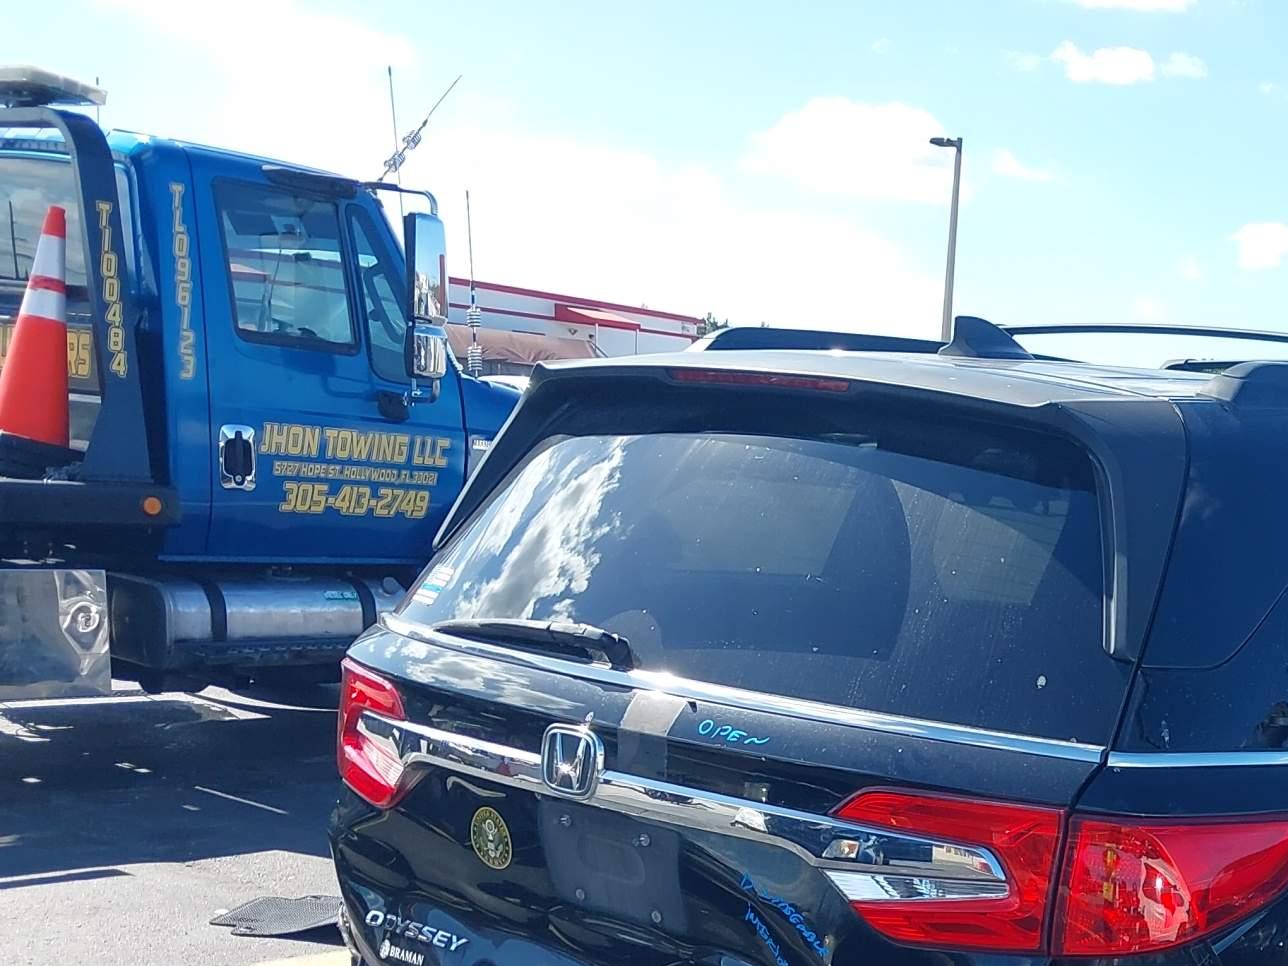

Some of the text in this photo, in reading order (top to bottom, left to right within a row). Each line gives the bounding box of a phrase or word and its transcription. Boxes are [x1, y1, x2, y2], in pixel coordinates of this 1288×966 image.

[259, 422, 450, 467] JHON TOWING LLC
[301, 462, 327, 478] HOPE
[279, 481, 430, 519] 305-413-2749
[365, 909, 469, 951] ODYSSEY
[390, 945, 424, 966] BRAMAN
